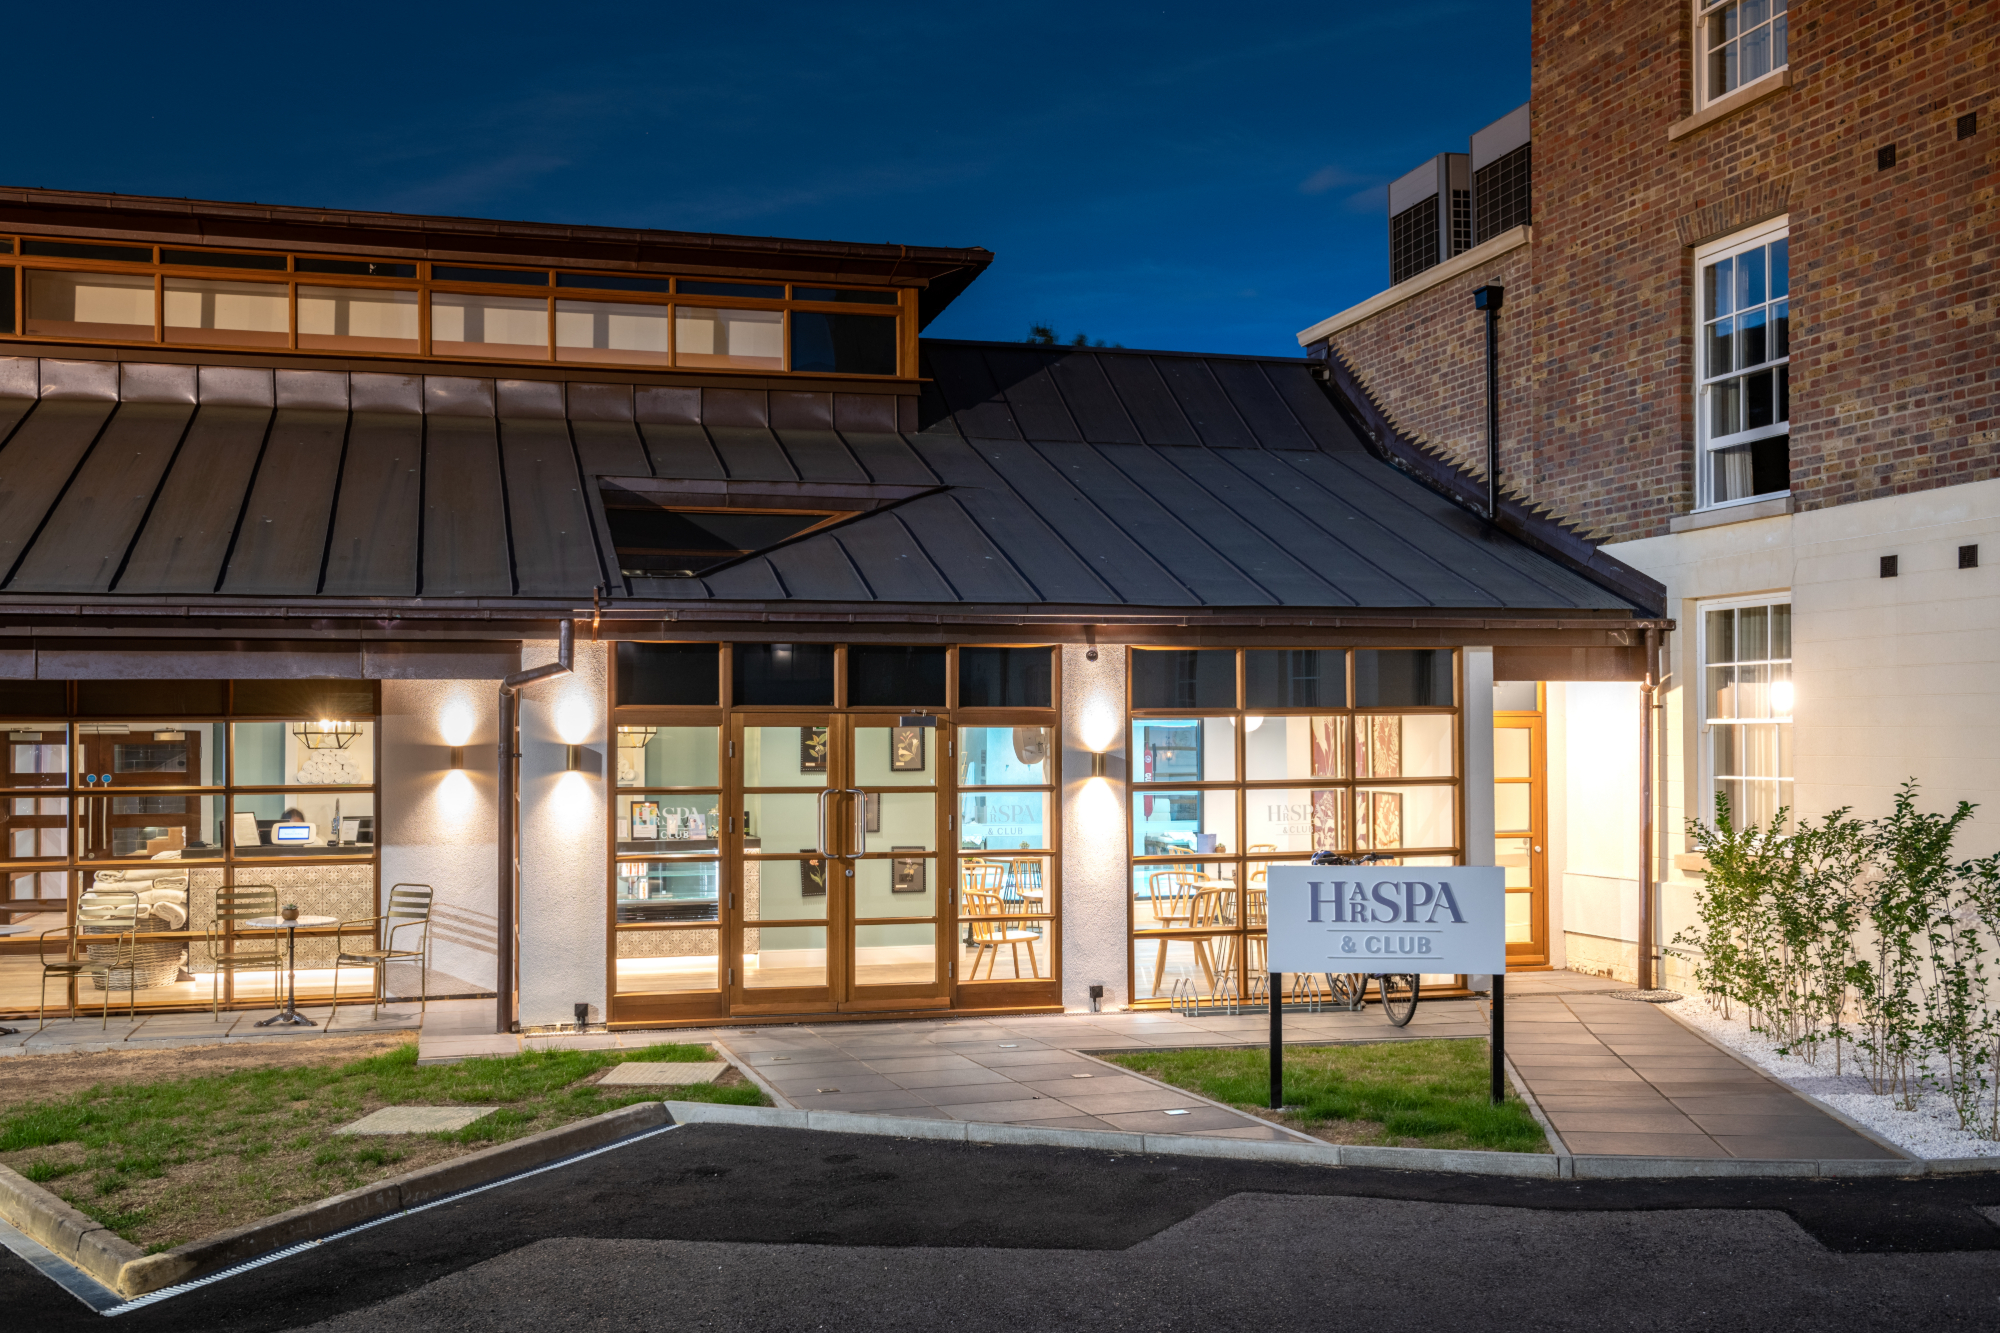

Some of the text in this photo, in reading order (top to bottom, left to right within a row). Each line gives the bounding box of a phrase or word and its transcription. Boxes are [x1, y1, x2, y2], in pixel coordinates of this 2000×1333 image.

[660, 831, 689, 839] CLUB
[997, 827, 1023, 835] CLUB
[1340, 935, 1432, 955] & CLUB
